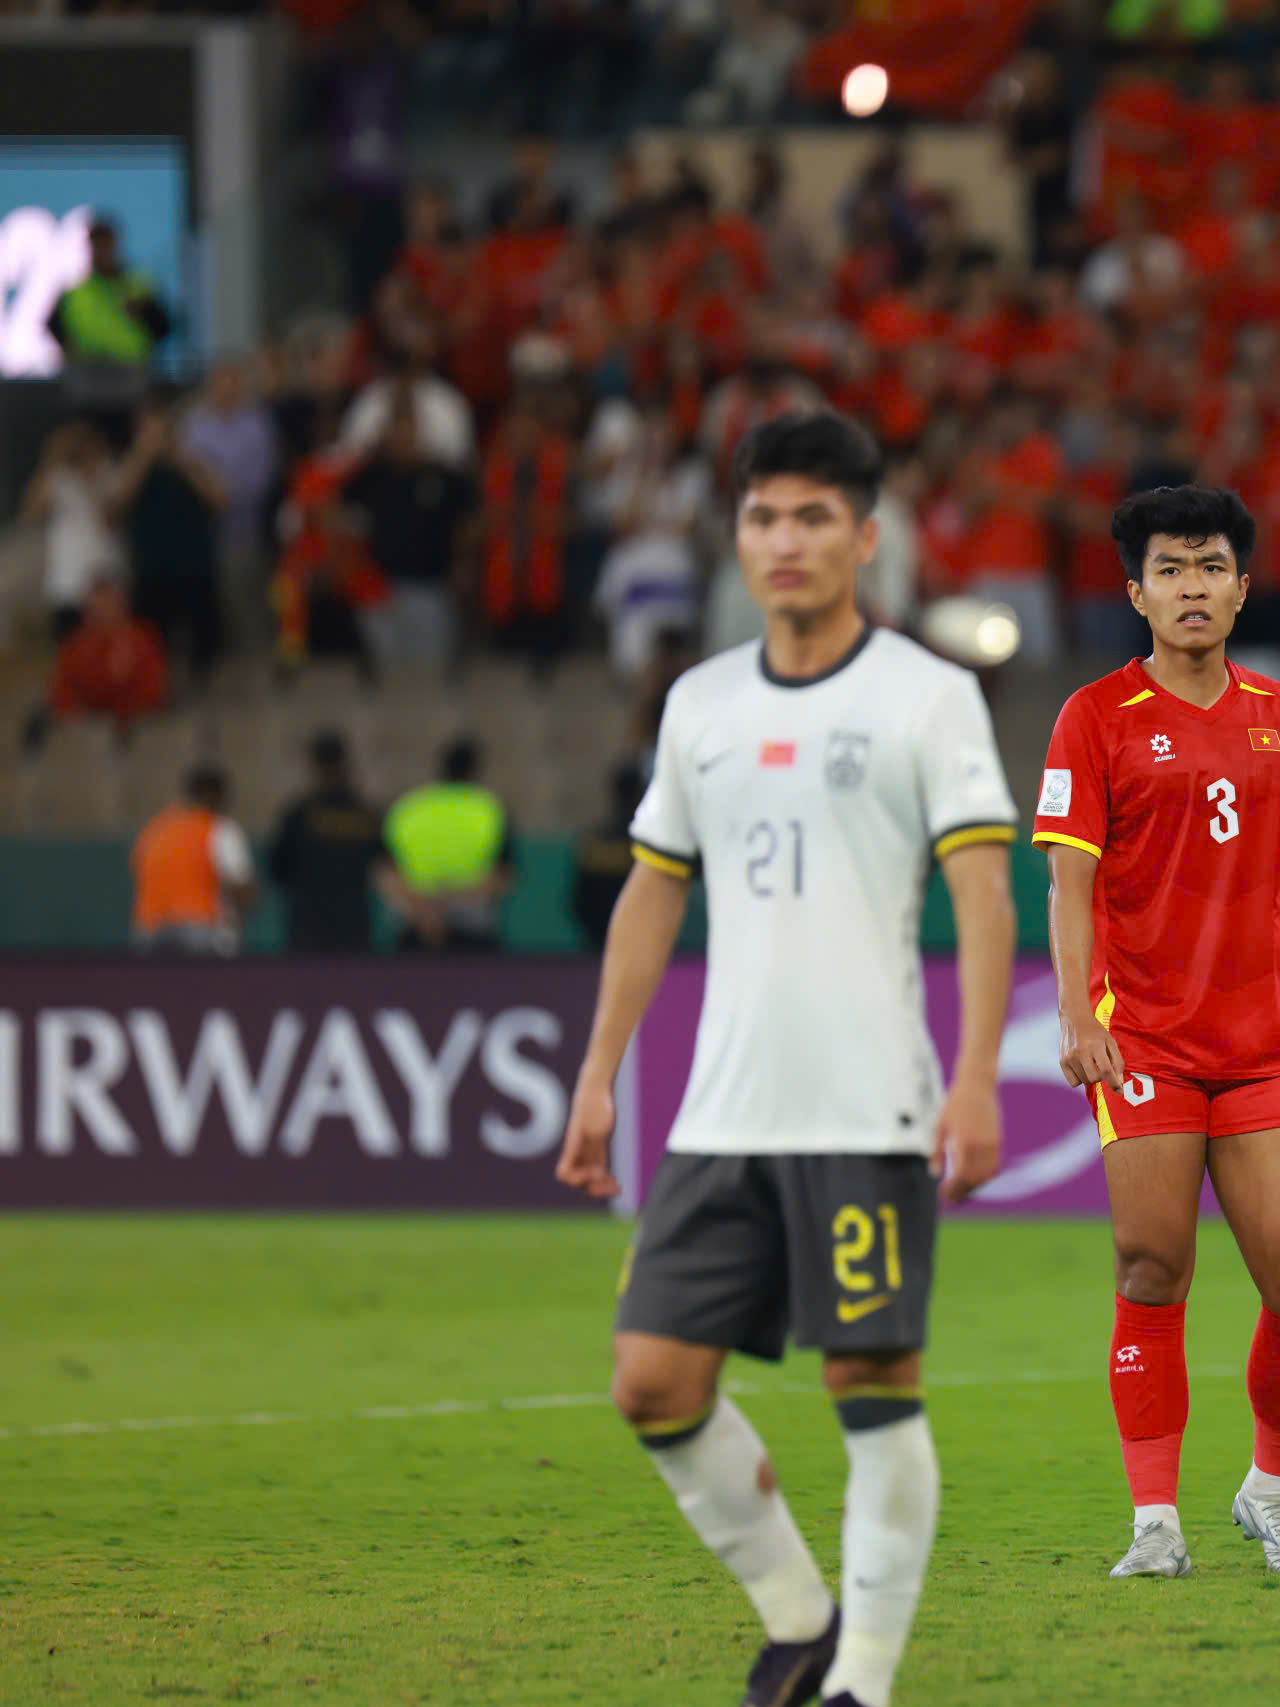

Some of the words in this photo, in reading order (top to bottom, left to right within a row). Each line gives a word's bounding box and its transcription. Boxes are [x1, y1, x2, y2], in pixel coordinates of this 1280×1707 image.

[1206, 777, 1240, 844] 3
[745, 819, 804, 900] 21
[832, 1204, 902, 1291] 21
